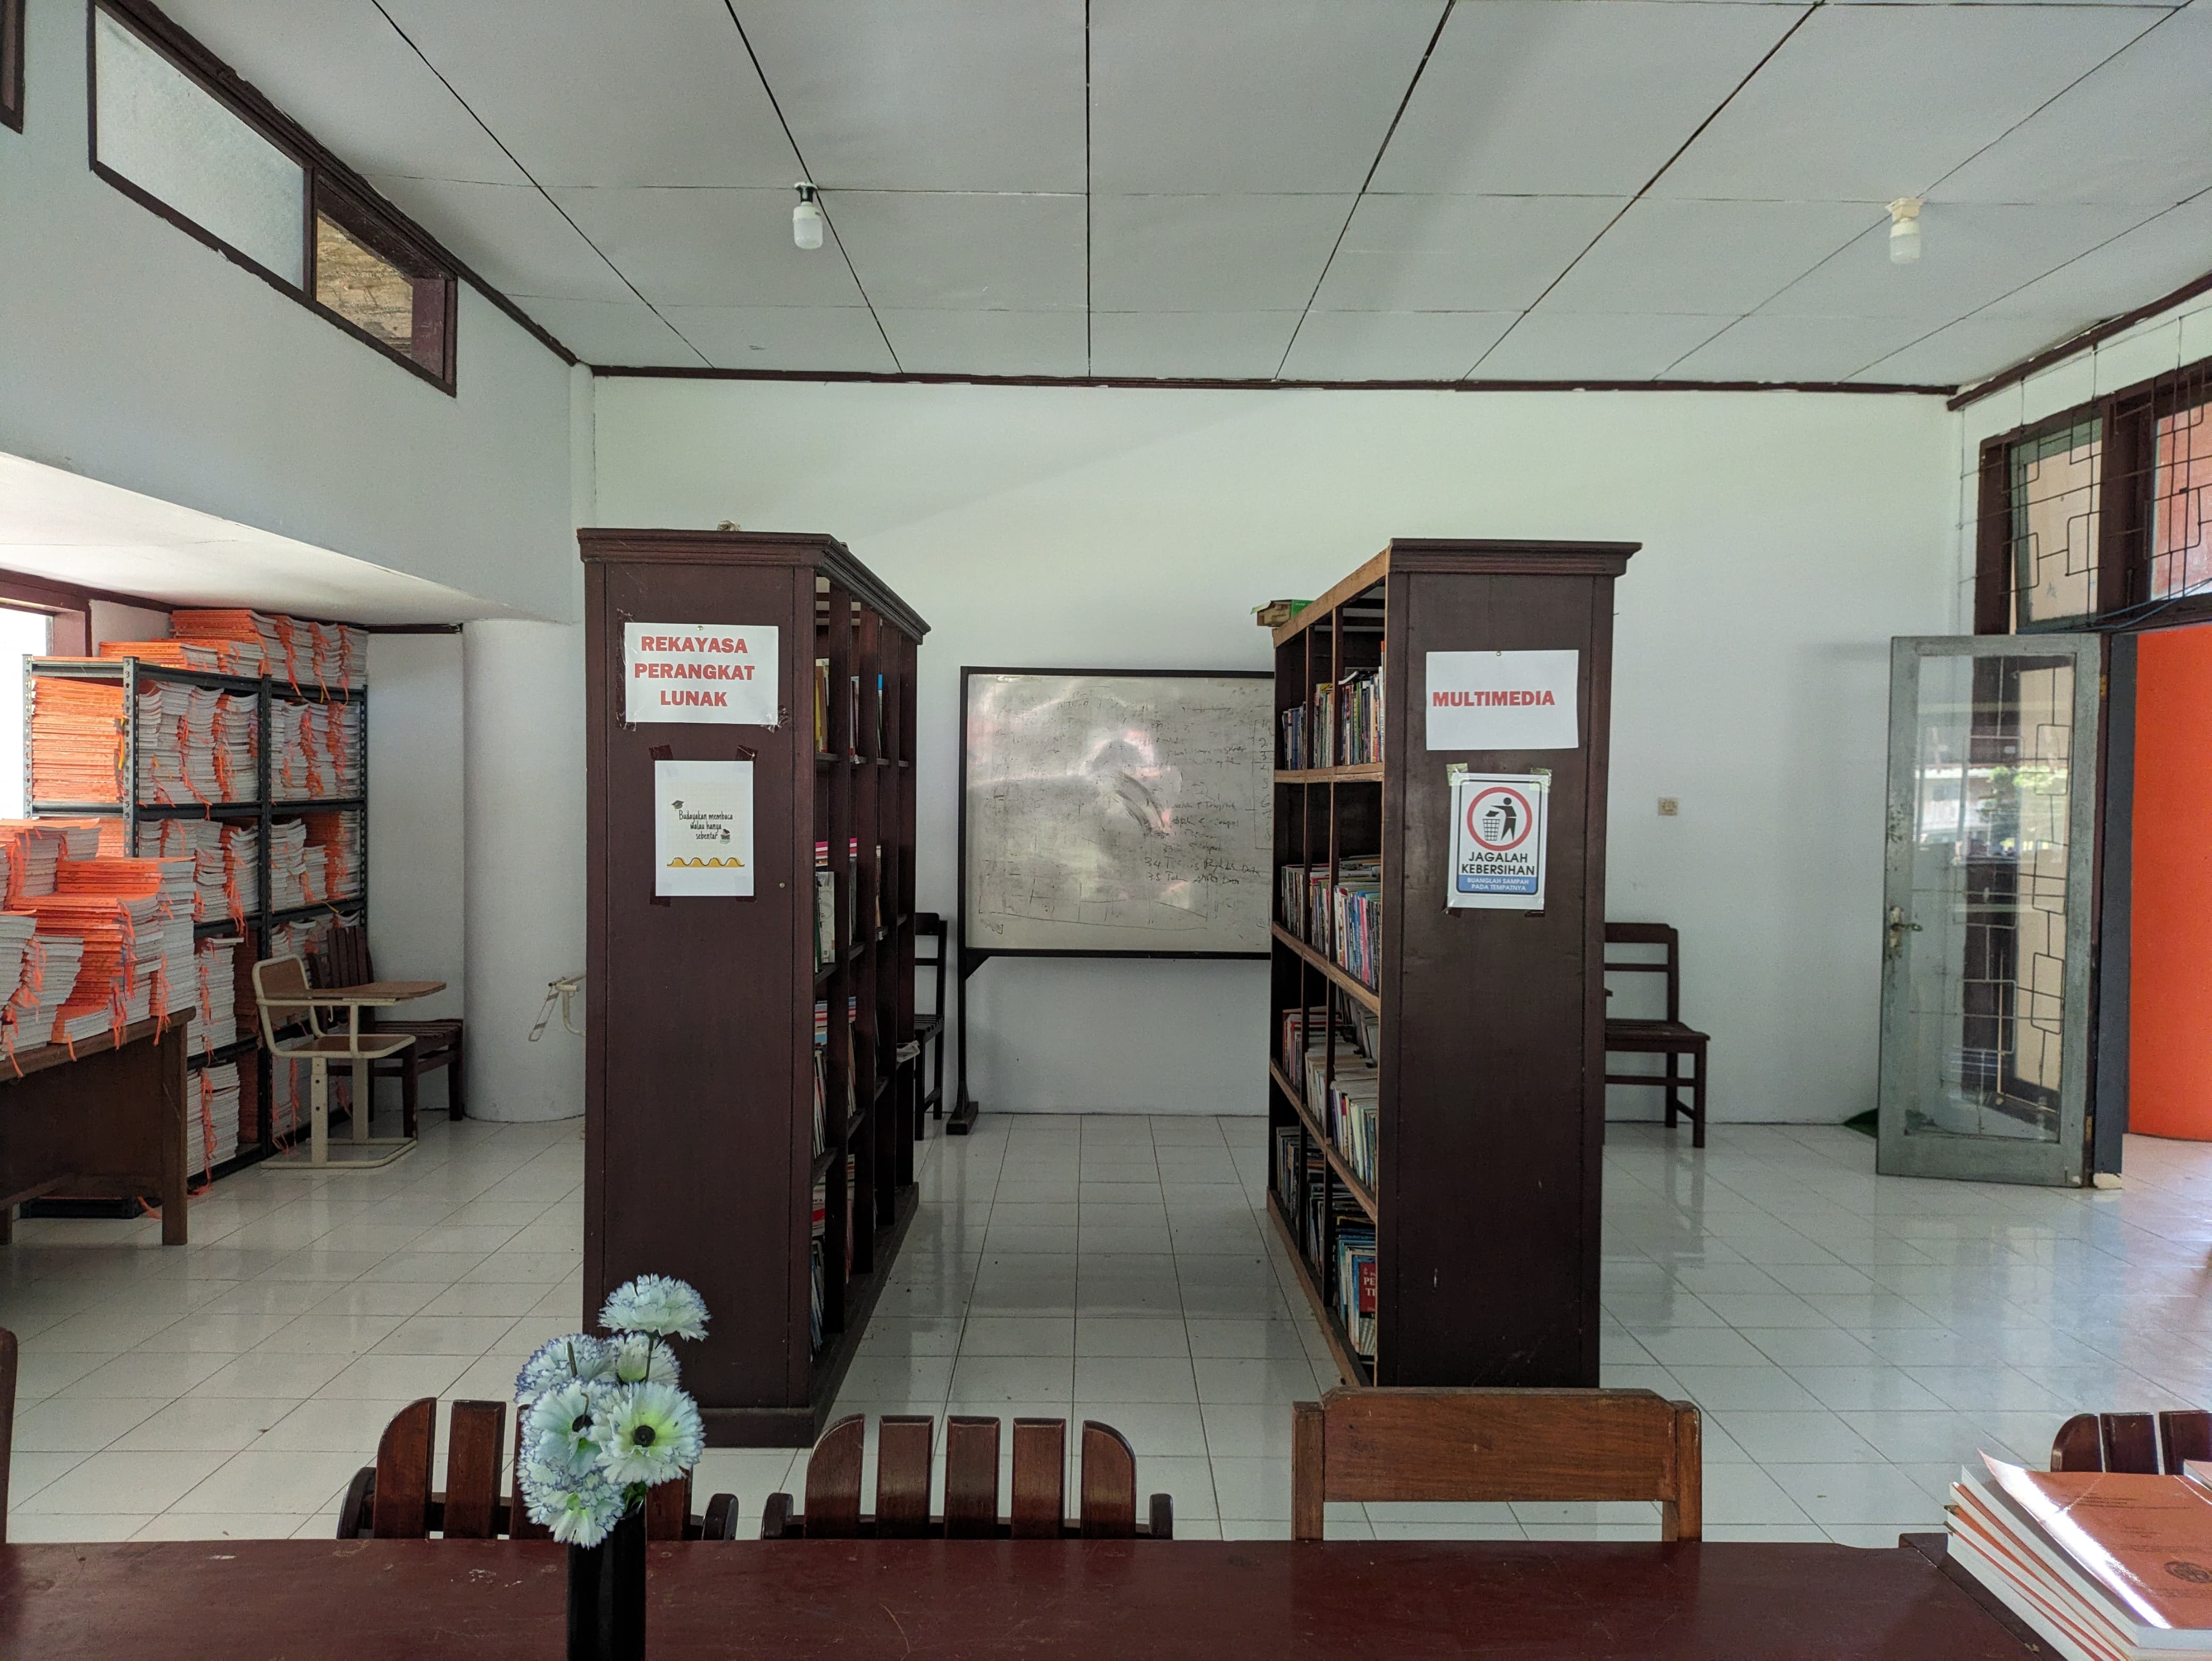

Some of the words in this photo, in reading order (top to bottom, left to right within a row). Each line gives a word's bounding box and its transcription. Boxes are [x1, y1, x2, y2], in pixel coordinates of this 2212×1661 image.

[641, 636, 748, 654] REKAYASA
[634, 663, 756, 681] PERANGKAT
[660, 690, 728, 707] LUNAK
[1432, 690, 1556, 707] MULTIMEDIA
[678, 809, 707, 824] Budayakan
[708, 811, 733, 820] membaca
[690, 820, 705, 830] walau
[706, 821, 722, 834] hanya
[696, 830, 718, 839] sebentar
[1468, 852, 1528, 863] JAGALAH
[1462, 864, 1535, 875] KEBERSIHAN
